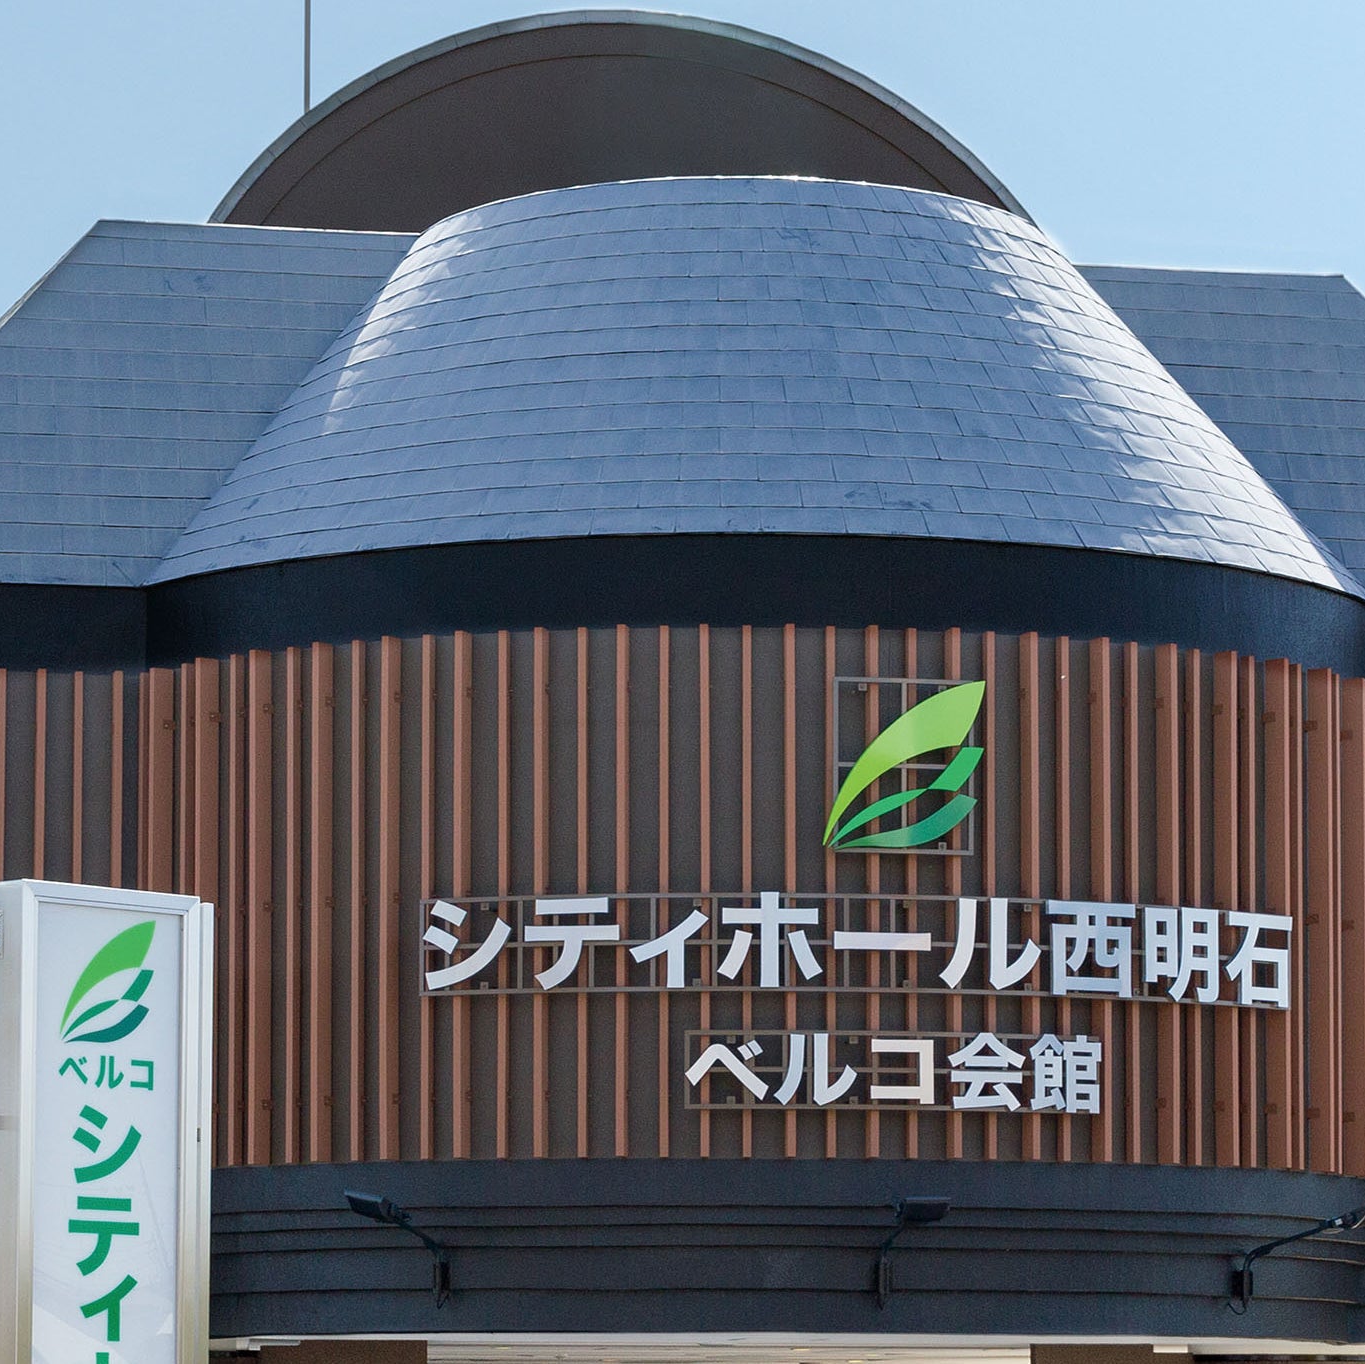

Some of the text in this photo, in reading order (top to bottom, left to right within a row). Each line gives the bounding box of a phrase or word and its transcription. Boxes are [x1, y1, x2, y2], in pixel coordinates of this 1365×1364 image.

[422, 891, 1293, 1008] シティホール西明石
[58, 1055, 155, 1091] ベルコ
[685, 1031, 1103, 1114] ベルコ会館
[68, 1104, 142, 1364] シティ
